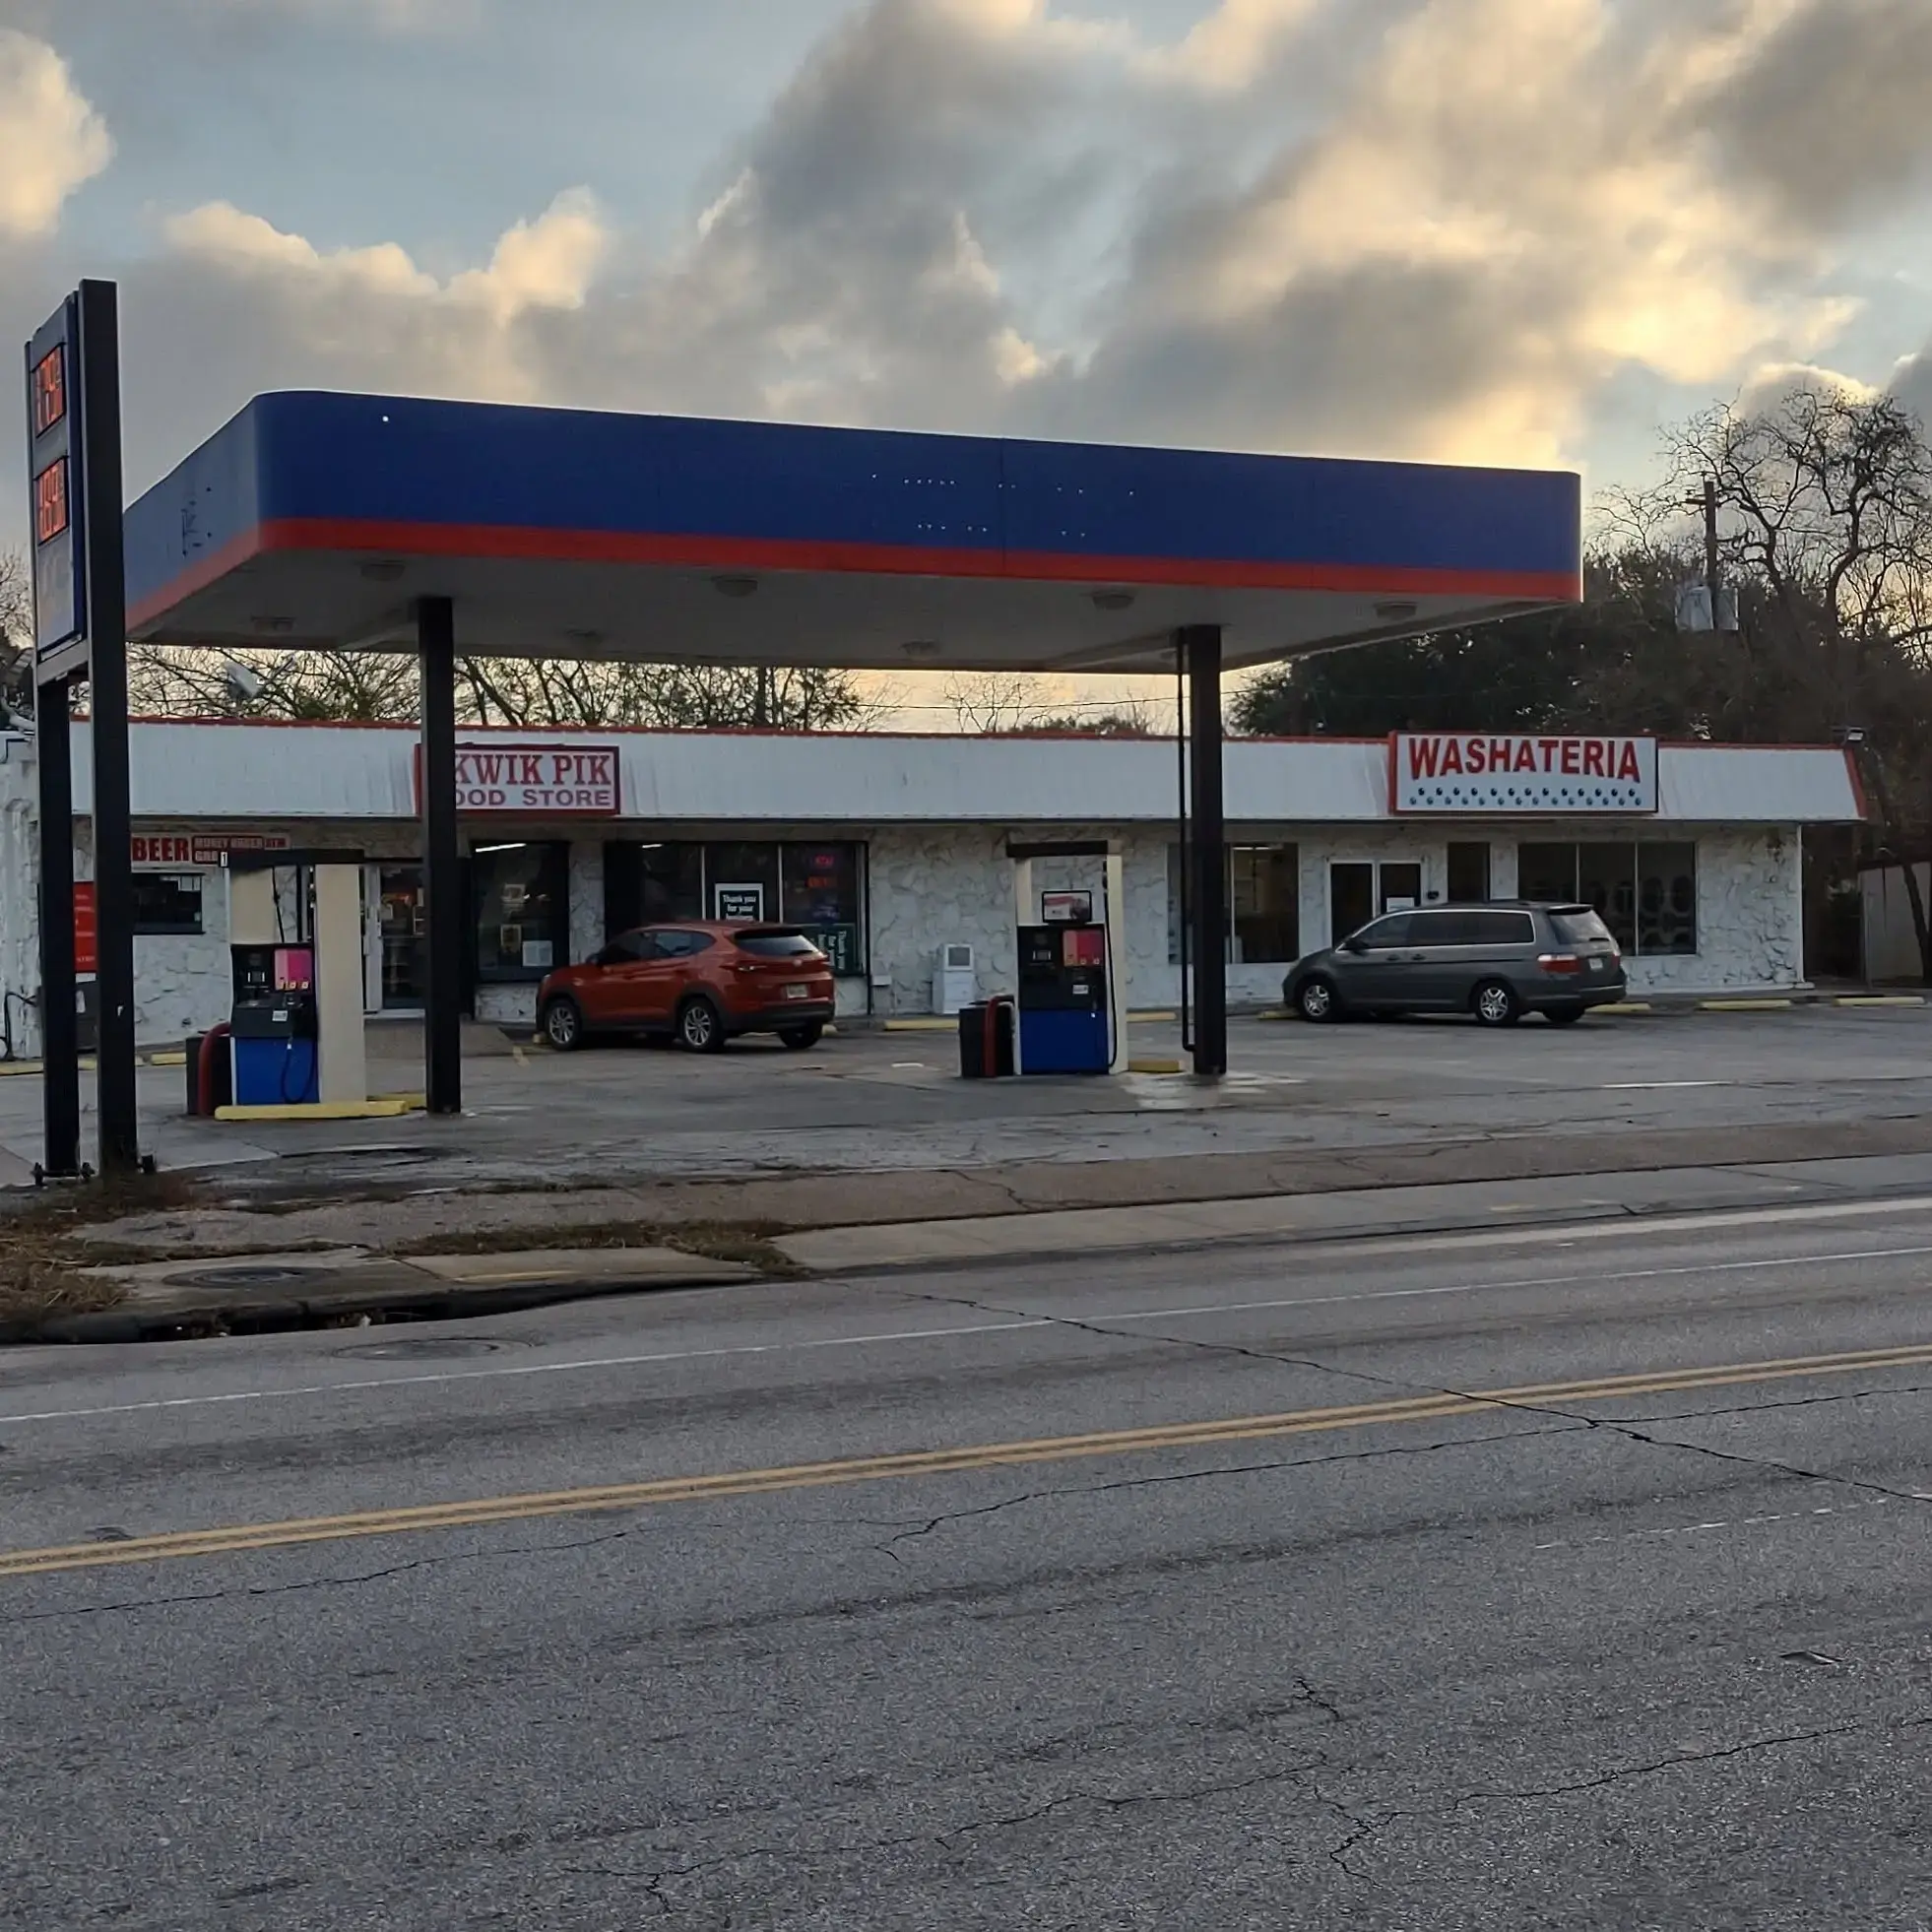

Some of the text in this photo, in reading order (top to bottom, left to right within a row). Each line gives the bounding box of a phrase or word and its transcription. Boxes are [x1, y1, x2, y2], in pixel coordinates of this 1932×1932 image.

[455, 753, 612, 786] KWIK PIK
[1408, 738, 1642, 783] WASHATERIA
[456, 789, 611, 806] OOD STORE
[132, 837, 190, 862] BEER
[723, 894, 742, 903] Thank
[727, 903, 739, 912] for
